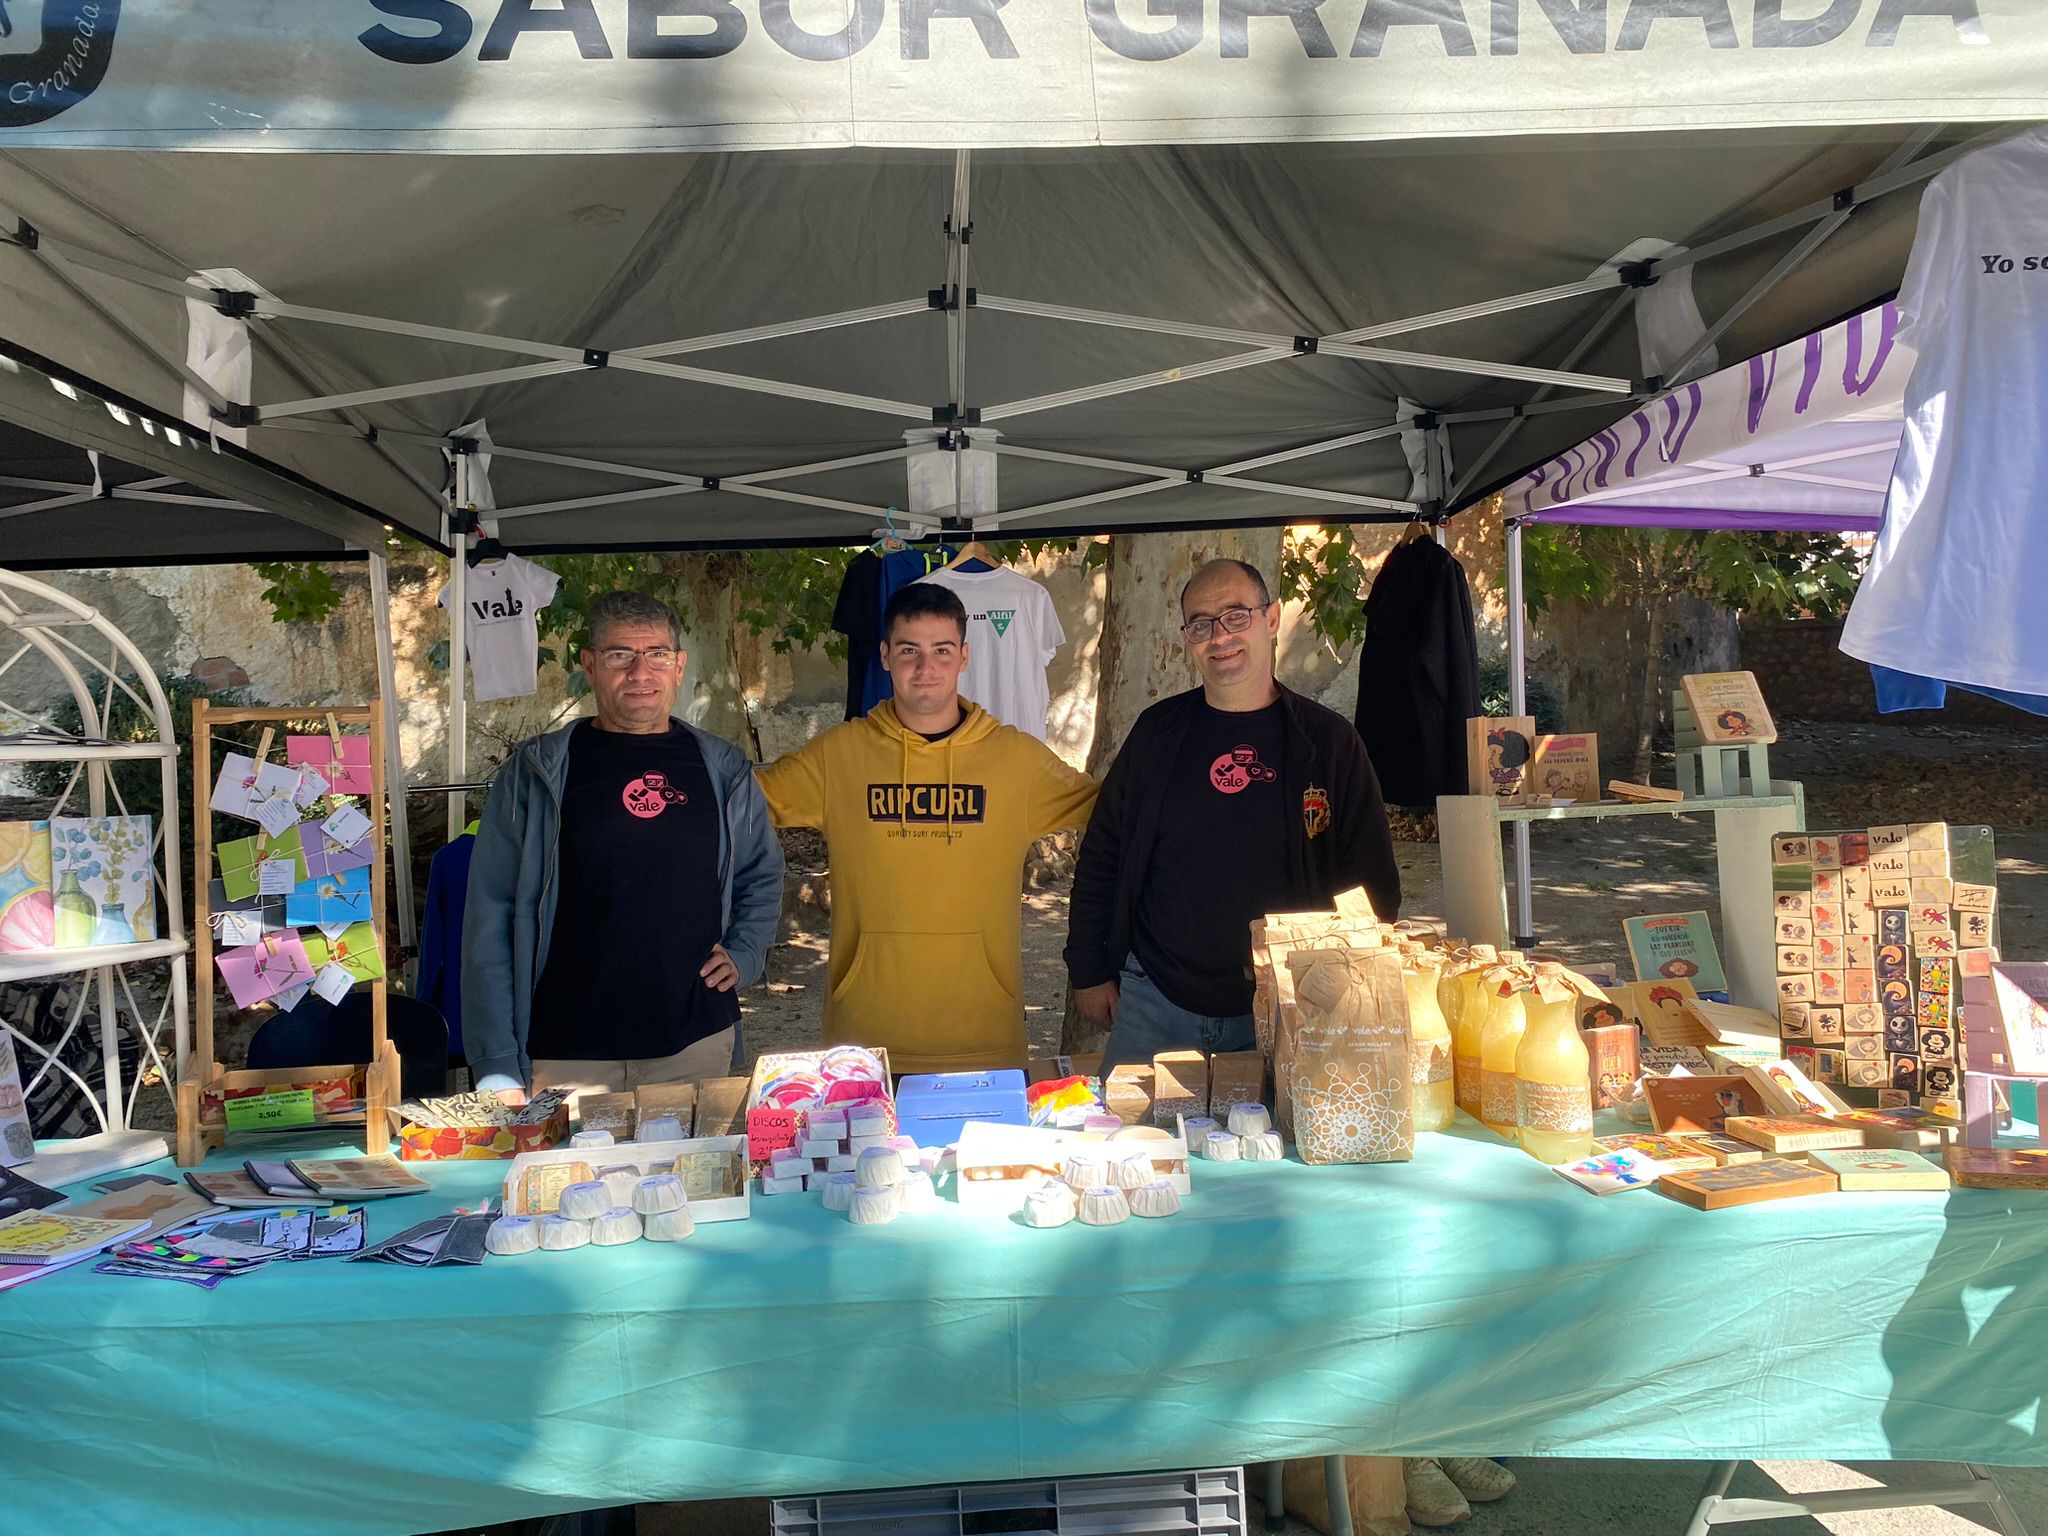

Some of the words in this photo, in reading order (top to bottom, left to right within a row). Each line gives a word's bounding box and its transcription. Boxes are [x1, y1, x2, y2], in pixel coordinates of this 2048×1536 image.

[357, 0, 1021, 65] SABOR
[8, 2, 101, 104] Granada
[1981, 254, 2014, 274] Yo
[990, 611, 1012, 620] Alfil
[1214, 773, 1245, 788] vale
[628, 798, 661, 812] vale
[887, 830, 911, 838] QUALTY
[1652, 1046, 1682, 1054] VIDA
[753, 1116, 789, 1128] DISCOS
